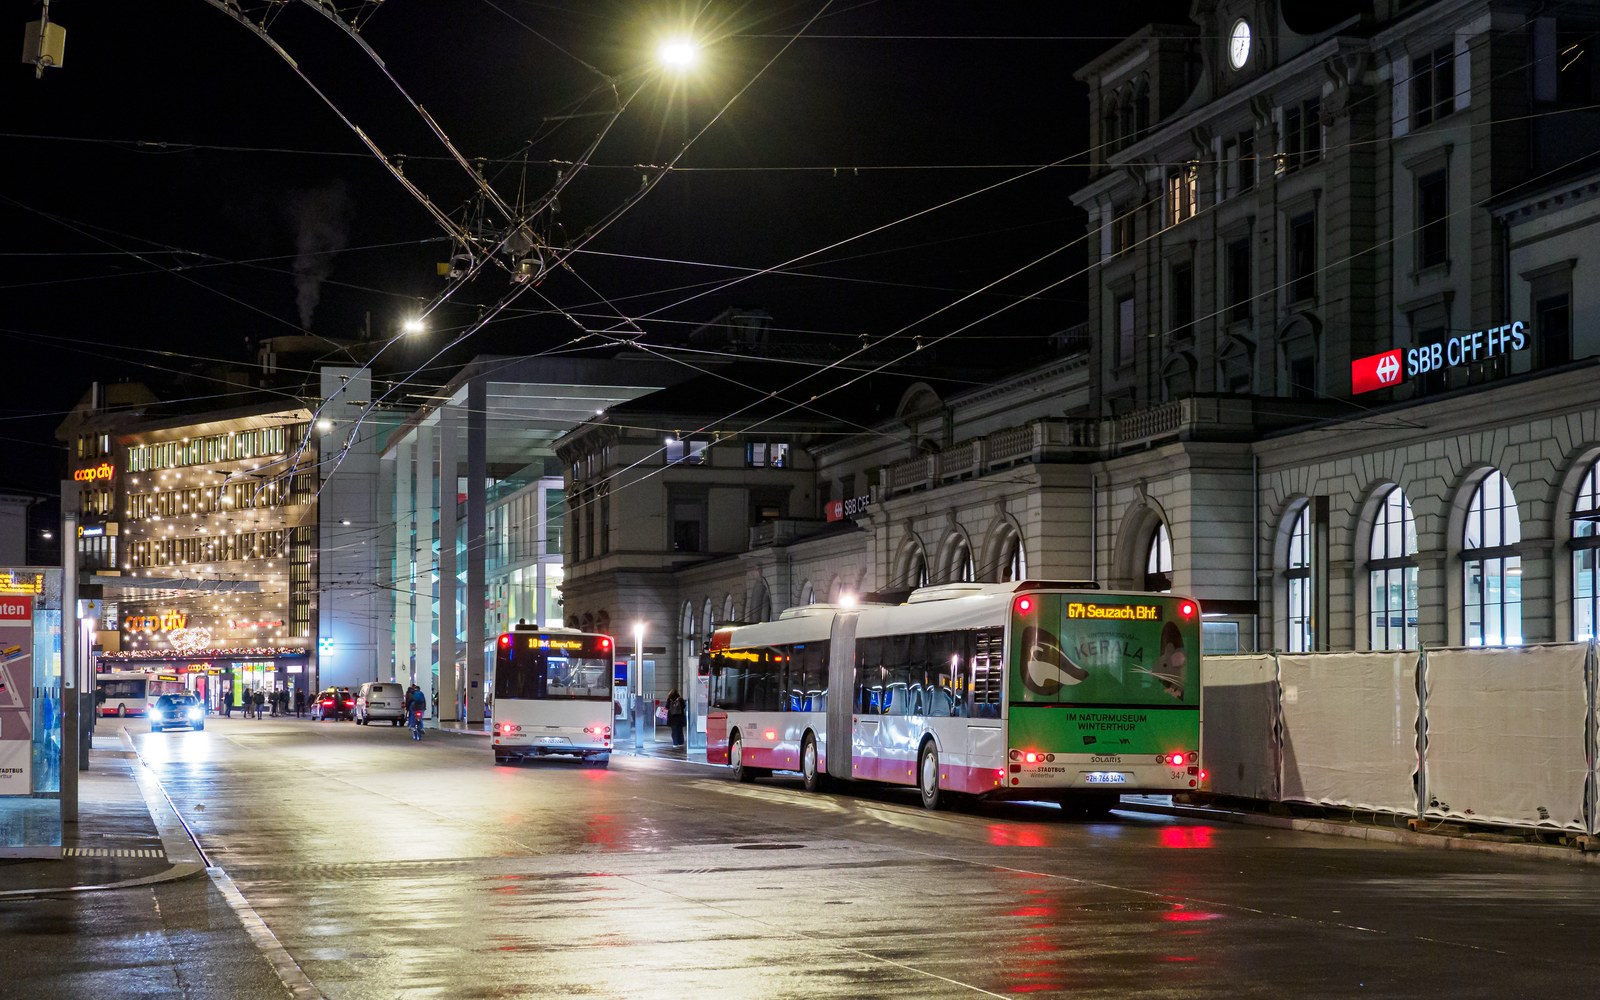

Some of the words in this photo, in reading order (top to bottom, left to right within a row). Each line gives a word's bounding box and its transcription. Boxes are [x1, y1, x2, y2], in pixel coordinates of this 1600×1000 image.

[1407, 342, 1443, 376] SBB
[1447, 331, 1483, 366] CFF
[1487, 320, 1526, 356] FFS
[74, 468, 96, 482] coop
[97, 463, 115, 480] city
[844, 498, 857, 516] SBB
[1068, 603, 1085, 618] 674
[1136, 606, 1158, 619] Bhf.
[125, 614, 160, 633] coop
[160, 608, 188, 631] city
[1074, 639, 1144, 662] KERALA
[1066, 713, 1077, 721] IM
[1079, 713, 1147, 723] NATURMUSEUM
[1078, 722, 1136, 731] WINTERTHUR
[1171, 770, 1185, 780] 347
